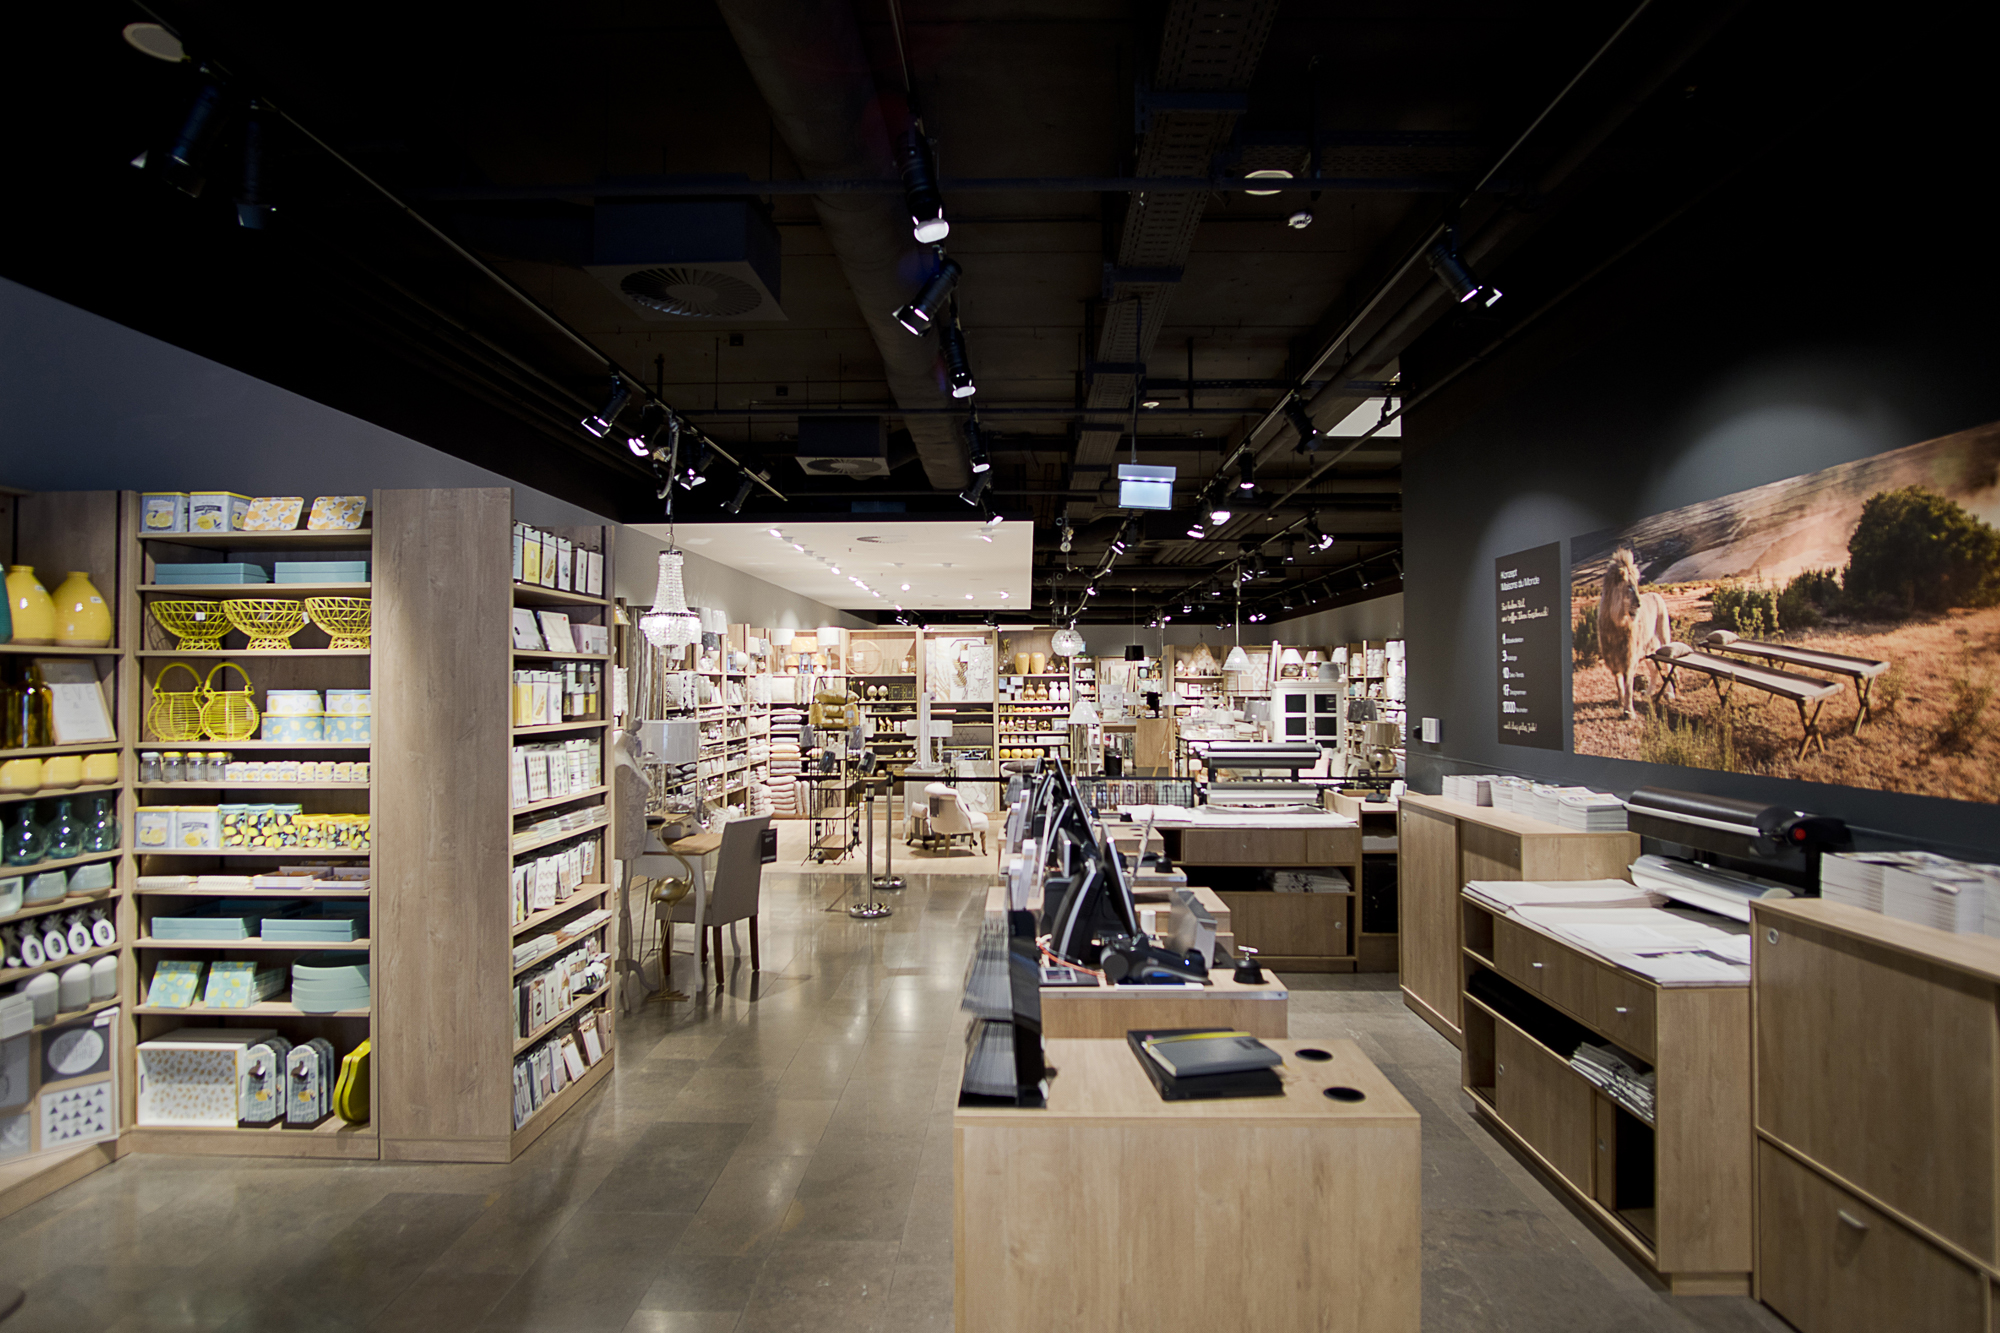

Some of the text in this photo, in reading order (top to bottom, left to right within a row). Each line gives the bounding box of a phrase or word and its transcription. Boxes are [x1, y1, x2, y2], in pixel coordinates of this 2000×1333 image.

[1500, 581, 1518, 591] Maisons
[1524, 576, 1541, 586] Monde
[1501, 649, 1507, 662] 3
